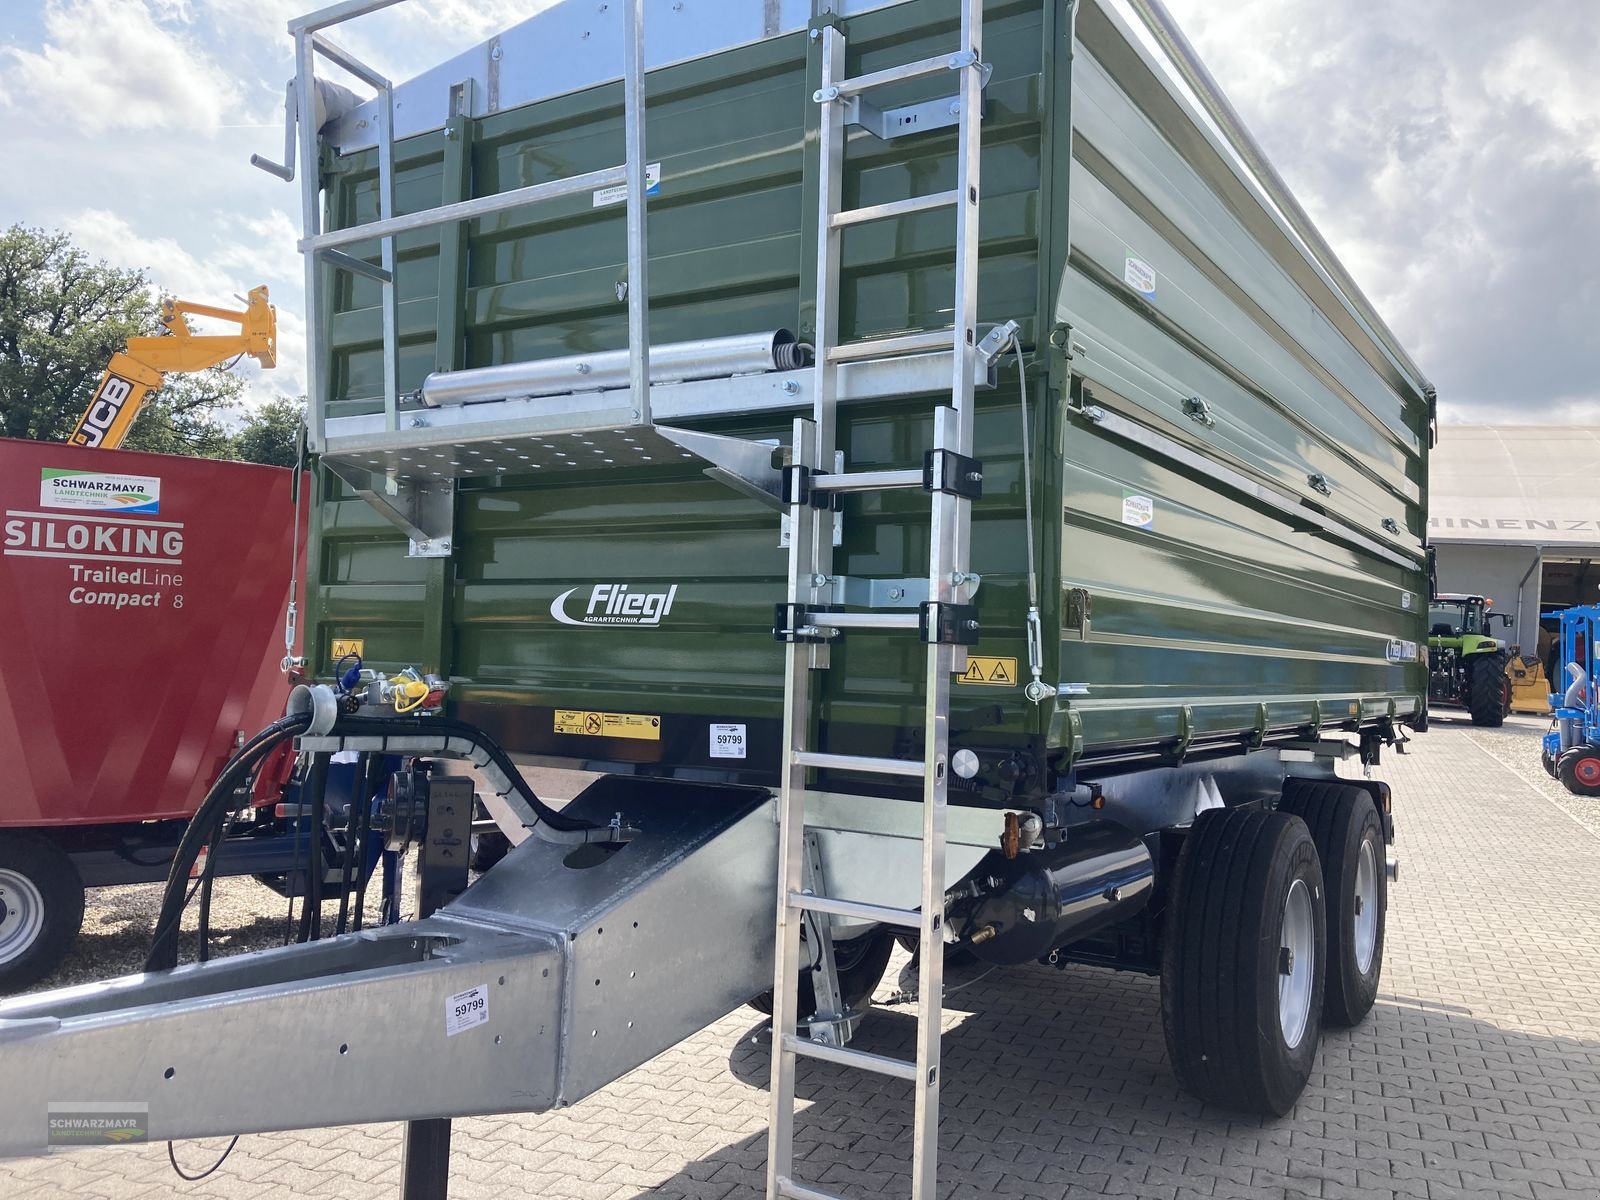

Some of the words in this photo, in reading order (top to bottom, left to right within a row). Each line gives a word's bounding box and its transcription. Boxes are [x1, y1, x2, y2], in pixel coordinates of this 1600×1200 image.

[86, 376, 131, 448] JCB
[53, 478, 145, 493] SCHWARZMAYR
[54, 489, 108, 499] LANDTECHNIK
[4, 520, 184, 555] SILOKING
[69, 564, 183, 586] TrailedLine
[69, 587, 161, 610] Compact
[173, 594, 184, 609] 8
[586, 584, 678, 624] Fliegl
[717, 735, 742, 744] 59799
[455, 998, 483, 1017] 59799
